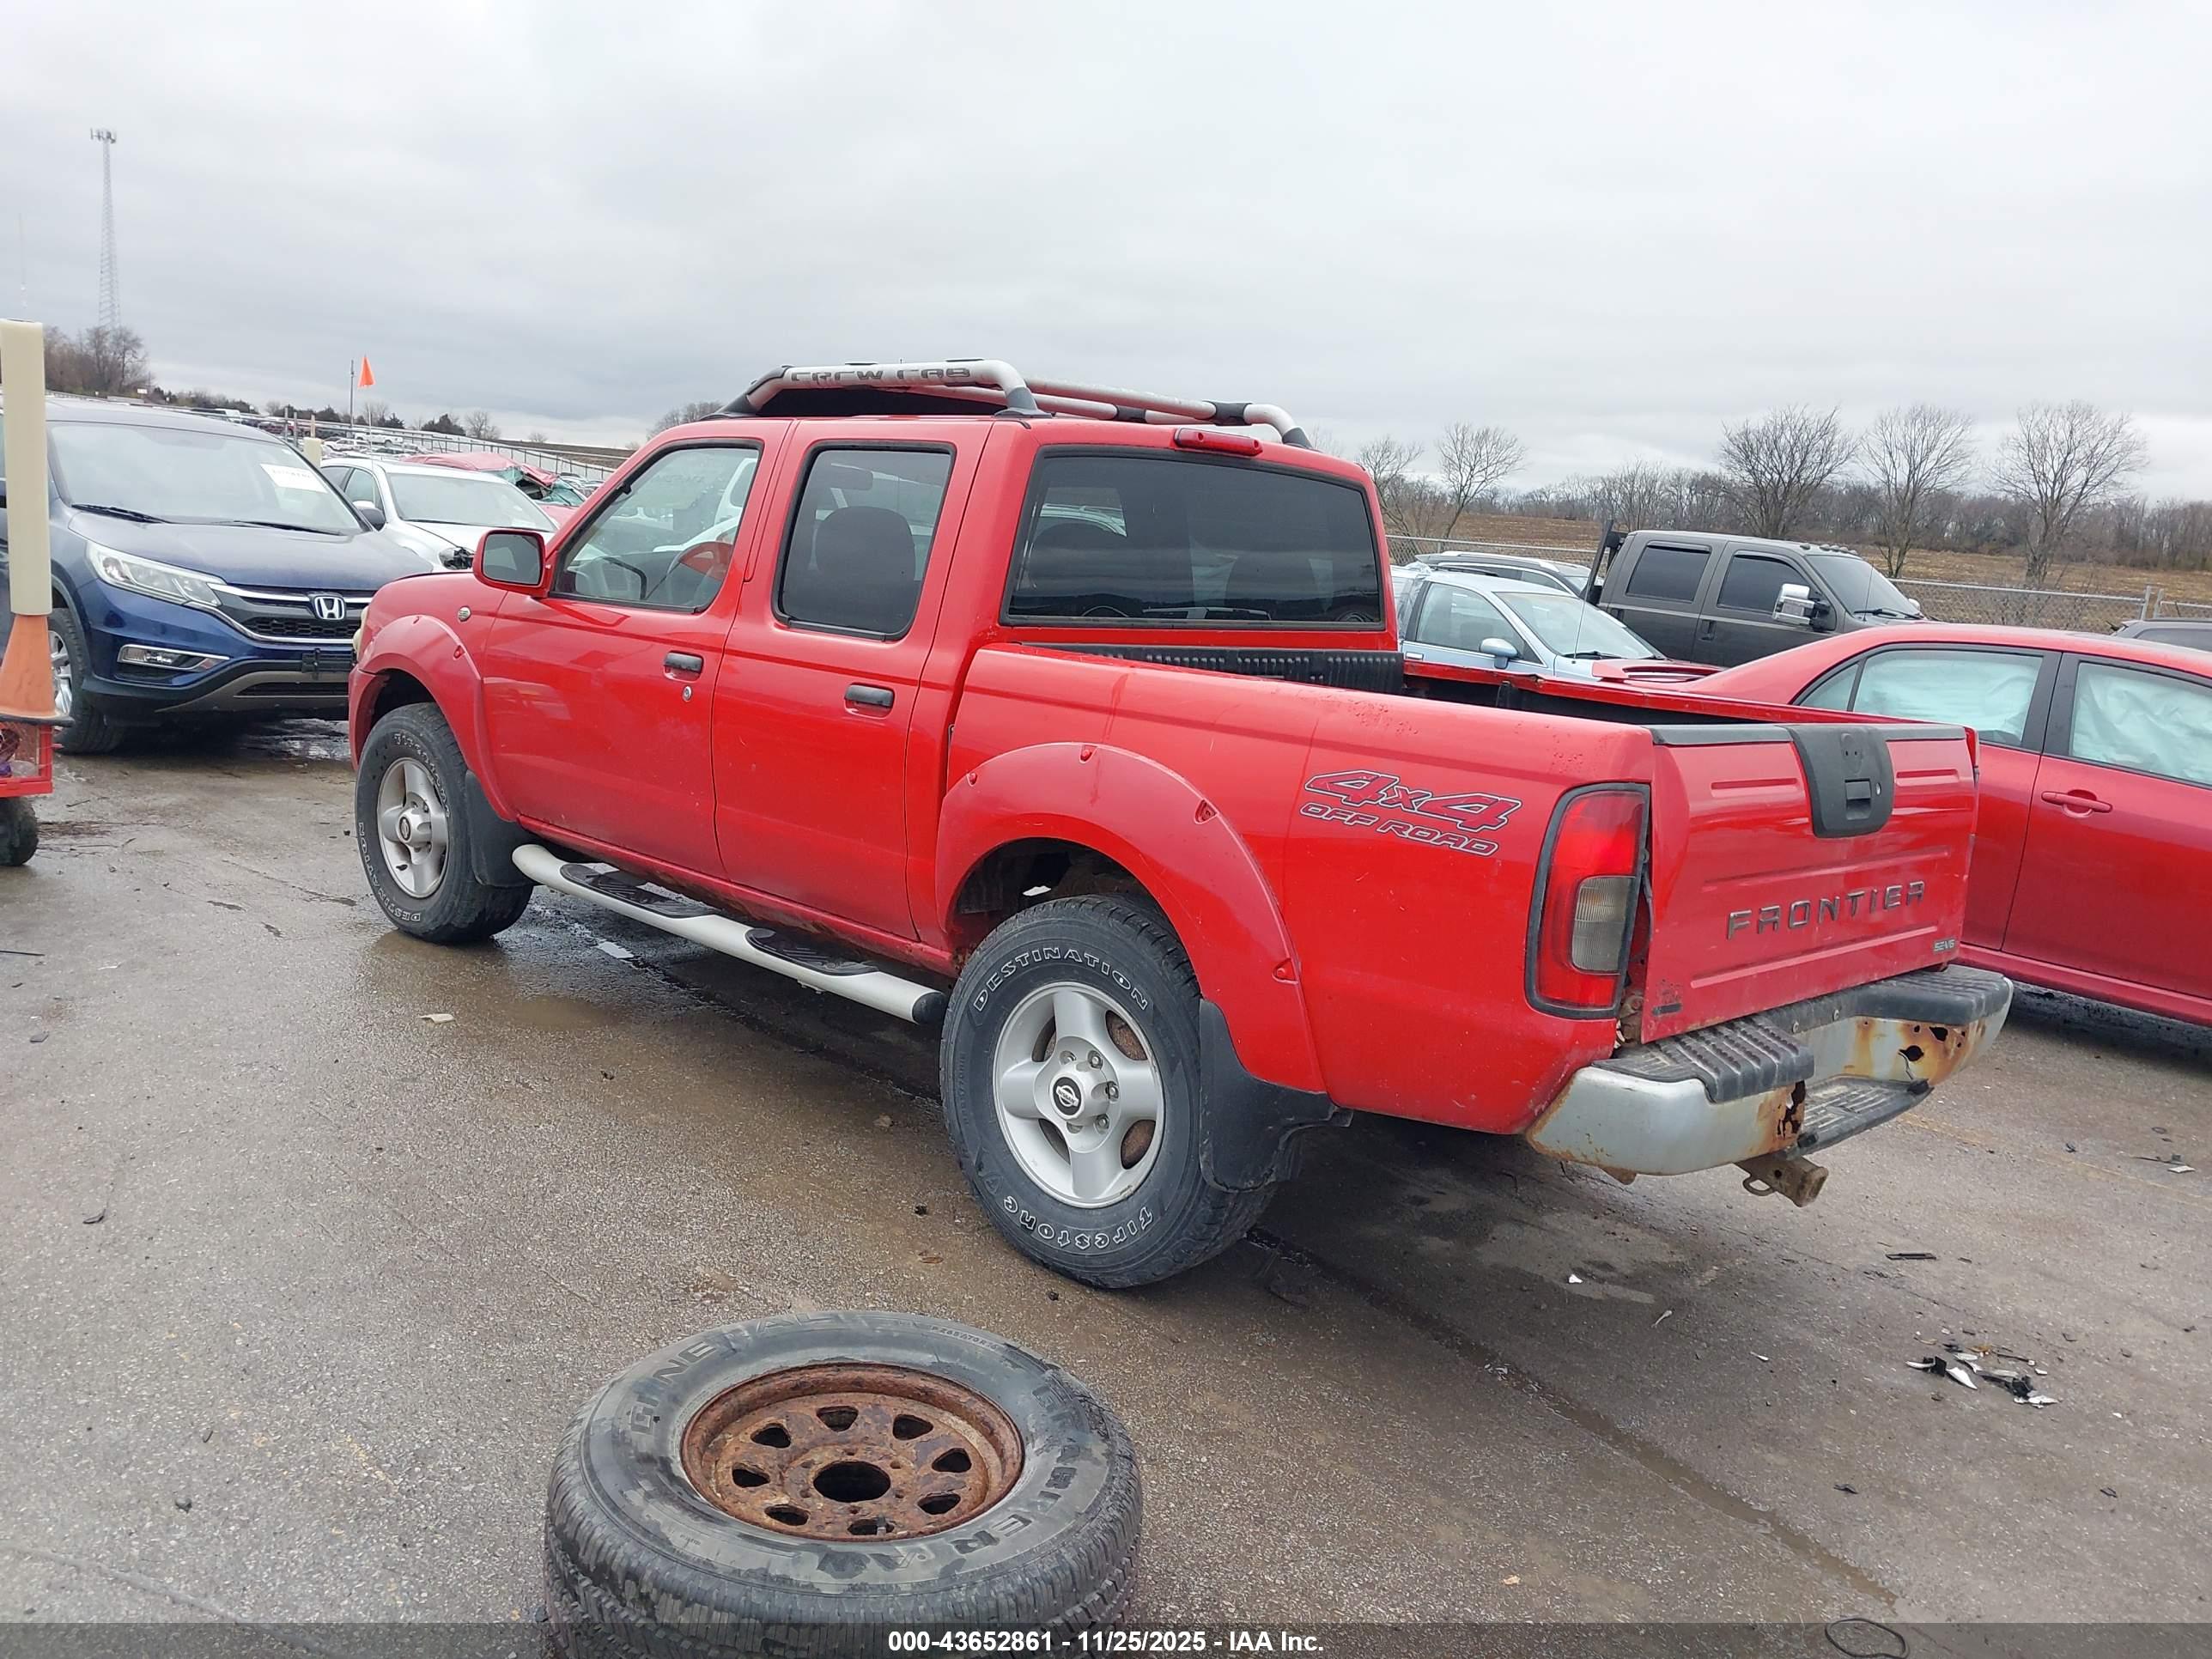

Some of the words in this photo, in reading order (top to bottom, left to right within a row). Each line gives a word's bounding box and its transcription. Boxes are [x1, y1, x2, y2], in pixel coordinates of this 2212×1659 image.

[791, 370, 884, 382] CREW
[896, 368, 970, 380] CAB
[1300, 802, 1379, 826] OFF
[1376, 818, 1498, 856] ROAD
[1304, 769, 1522, 832] 4x4
[1727, 880, 1924, 939] FRONTIER
[973, 947, 1148, 1012] DESTINATION
[1003, 1195, 1153, 1250] Firestone
